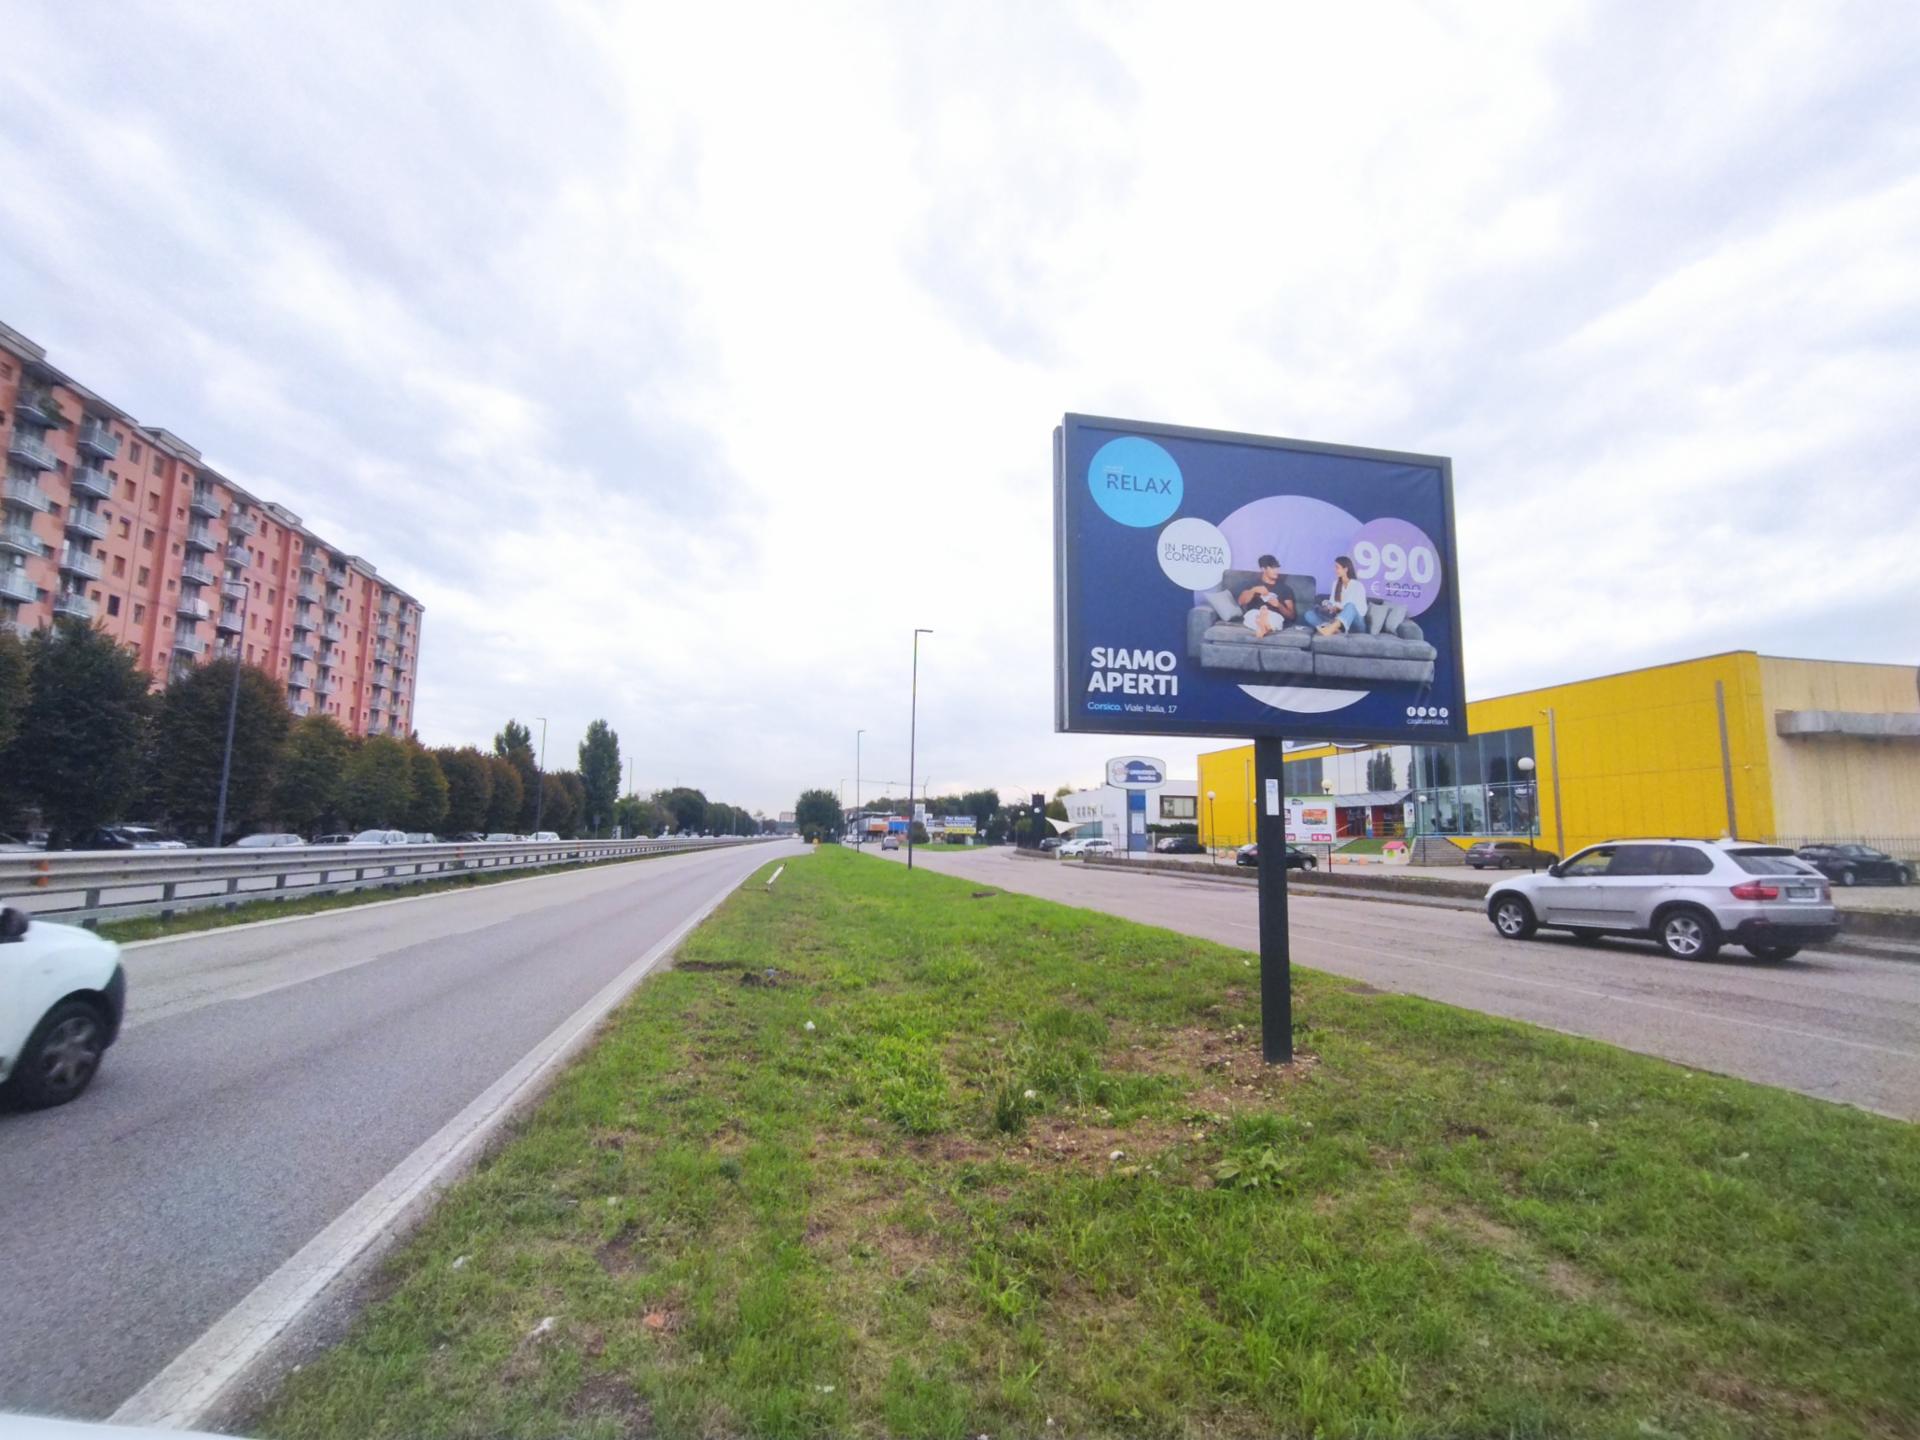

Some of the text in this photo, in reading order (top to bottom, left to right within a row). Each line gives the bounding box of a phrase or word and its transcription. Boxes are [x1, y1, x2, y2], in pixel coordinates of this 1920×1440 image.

[1106, 473, 1172, 495] RELAX
[1165, 543, 1224, 556] IN PRONTA
[1165, 551, 1225, 565] CONSEGNA
[1354, 541, 1434, 584] 990
[1385, 583, 1422, 599] 1290
[1090, 646, 1177, 672] SIAMO
[1087, 670, 1178, 696] APERTI
[1124, 703, 1144, 712] Viale
[1146, 704, 1166, 713] Italia,
[1168, 704, 1178, 713] 17
